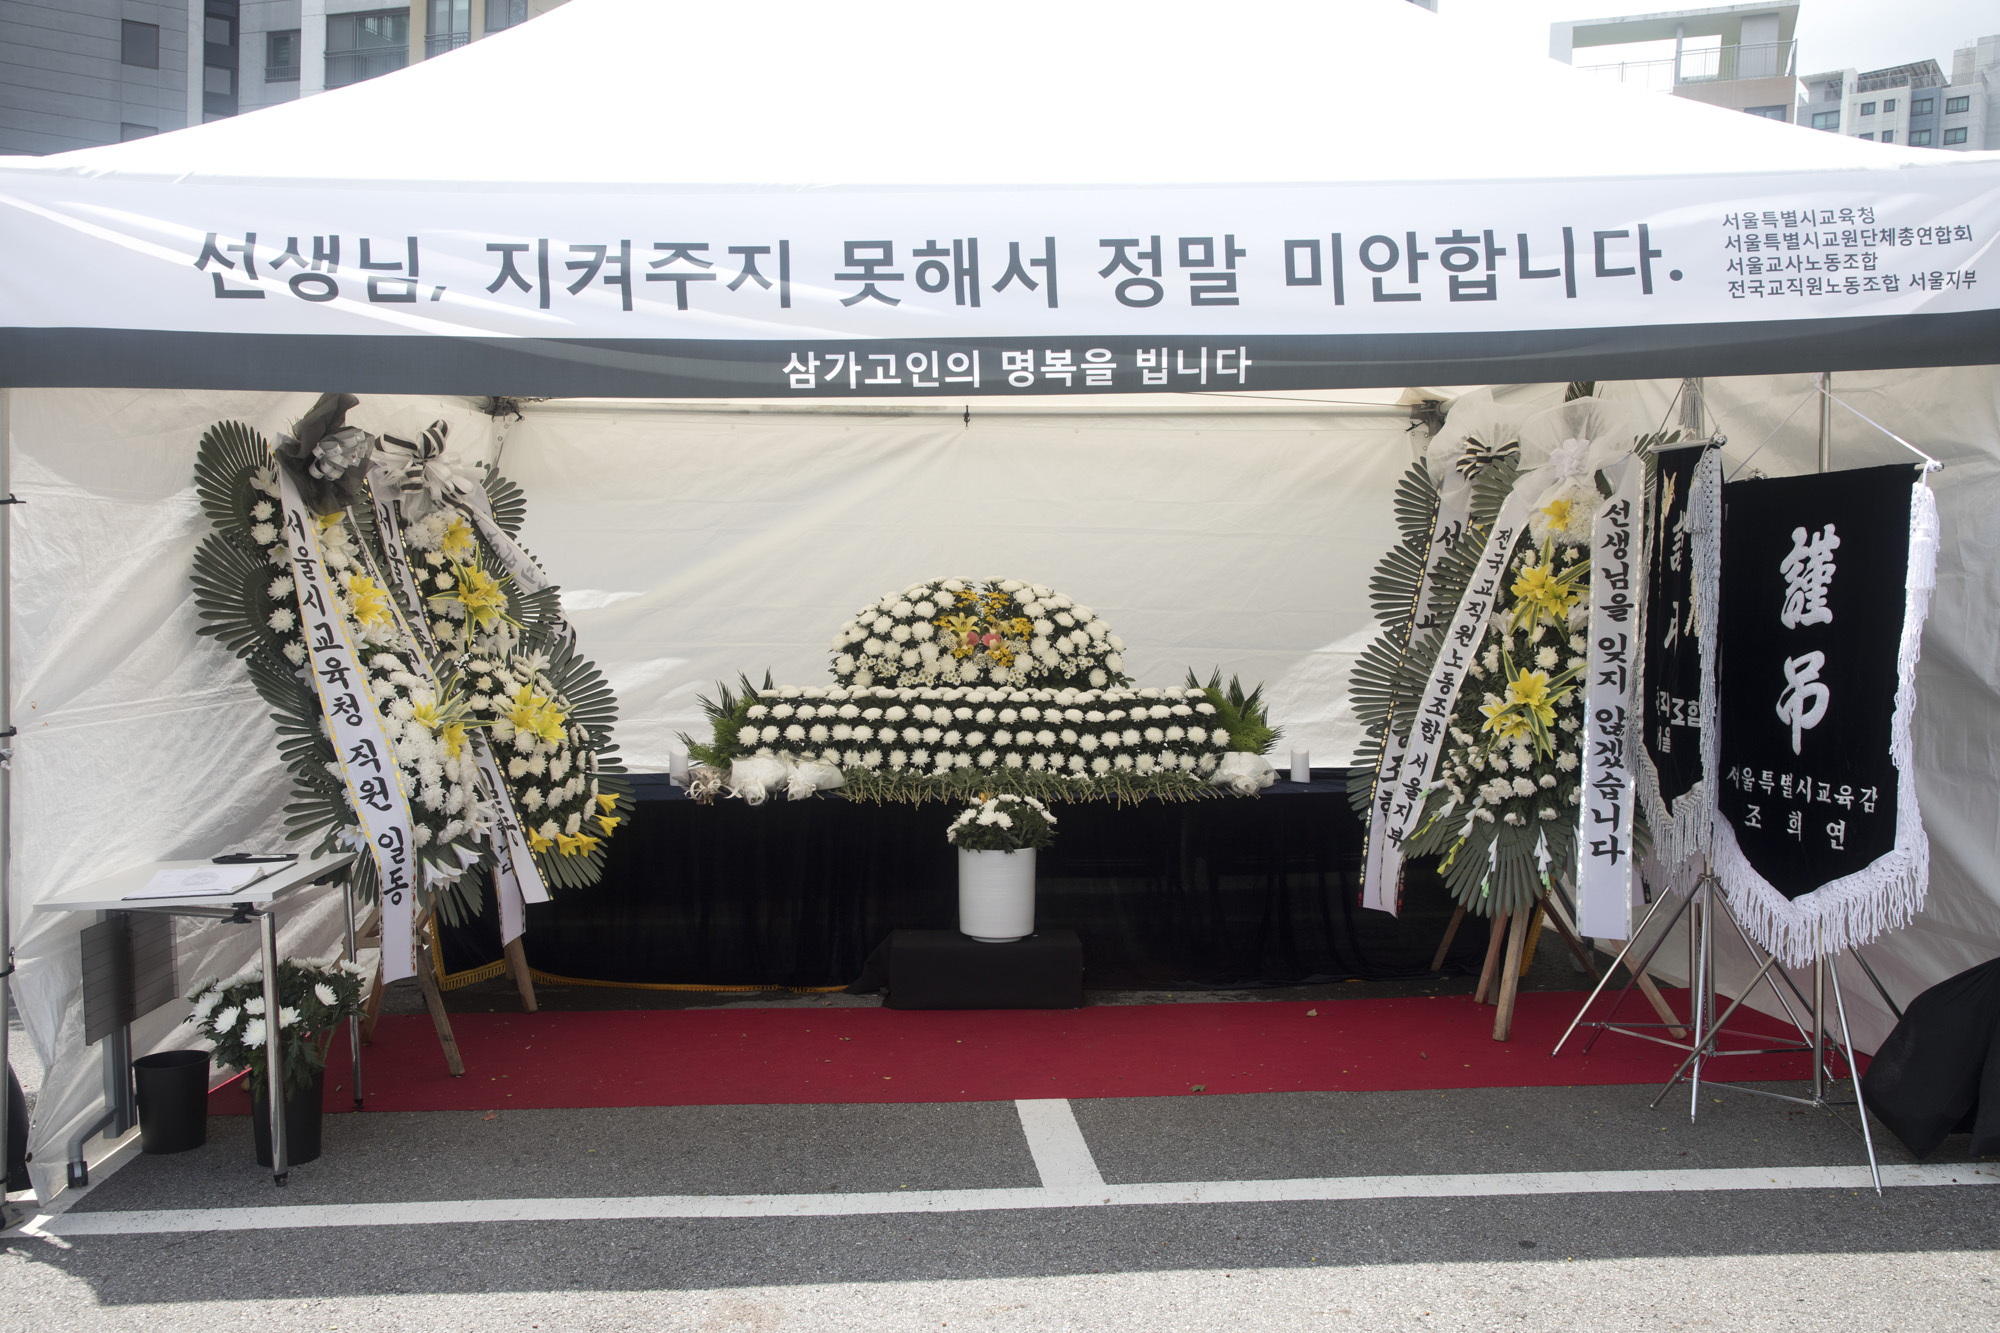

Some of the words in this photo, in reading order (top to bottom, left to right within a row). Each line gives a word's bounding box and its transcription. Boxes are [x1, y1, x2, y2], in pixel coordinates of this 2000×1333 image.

[1722, 206, 1876, 231] 서울특별시교육청
[1724, 224, 1974, 253] 서울특별시교원단체총연합회
[193, 231, 447, 303] 선생님,
[485, 238, 791, 311] 지켜주지
[834, 236, 1059, 308] 못해서
[1098, 234, 1247, 308] 정말
[1284, 223, 1683, 306] 미안합니다.
[1726, 251, 1879, 276] 서울교사노동조합
[1728, 273, 1900, 299] 전국교직원노동조합
[1909, 270, 1978, 291] 서울지부
[782, 349, 981, 389] 삼가고인의
[1000, 347, 1118, 386] 명복을
[1136, 346, 1252, 384] 빕니다
[1600, 499, 1634, 622] 선생님을
[1421, 527, 1513, 744] 전국교직원노동조합
[1597, 633, 1628, 695] 잊지
[286, 509, 363, 726] 서울시교육청
[347, 738, 393, 811] 직원
[377, 826, 409, 905] 일동
[1386, 752, 1430, 848] 서울지부
[1589, 705, 1626, 866] 않겠습니다
